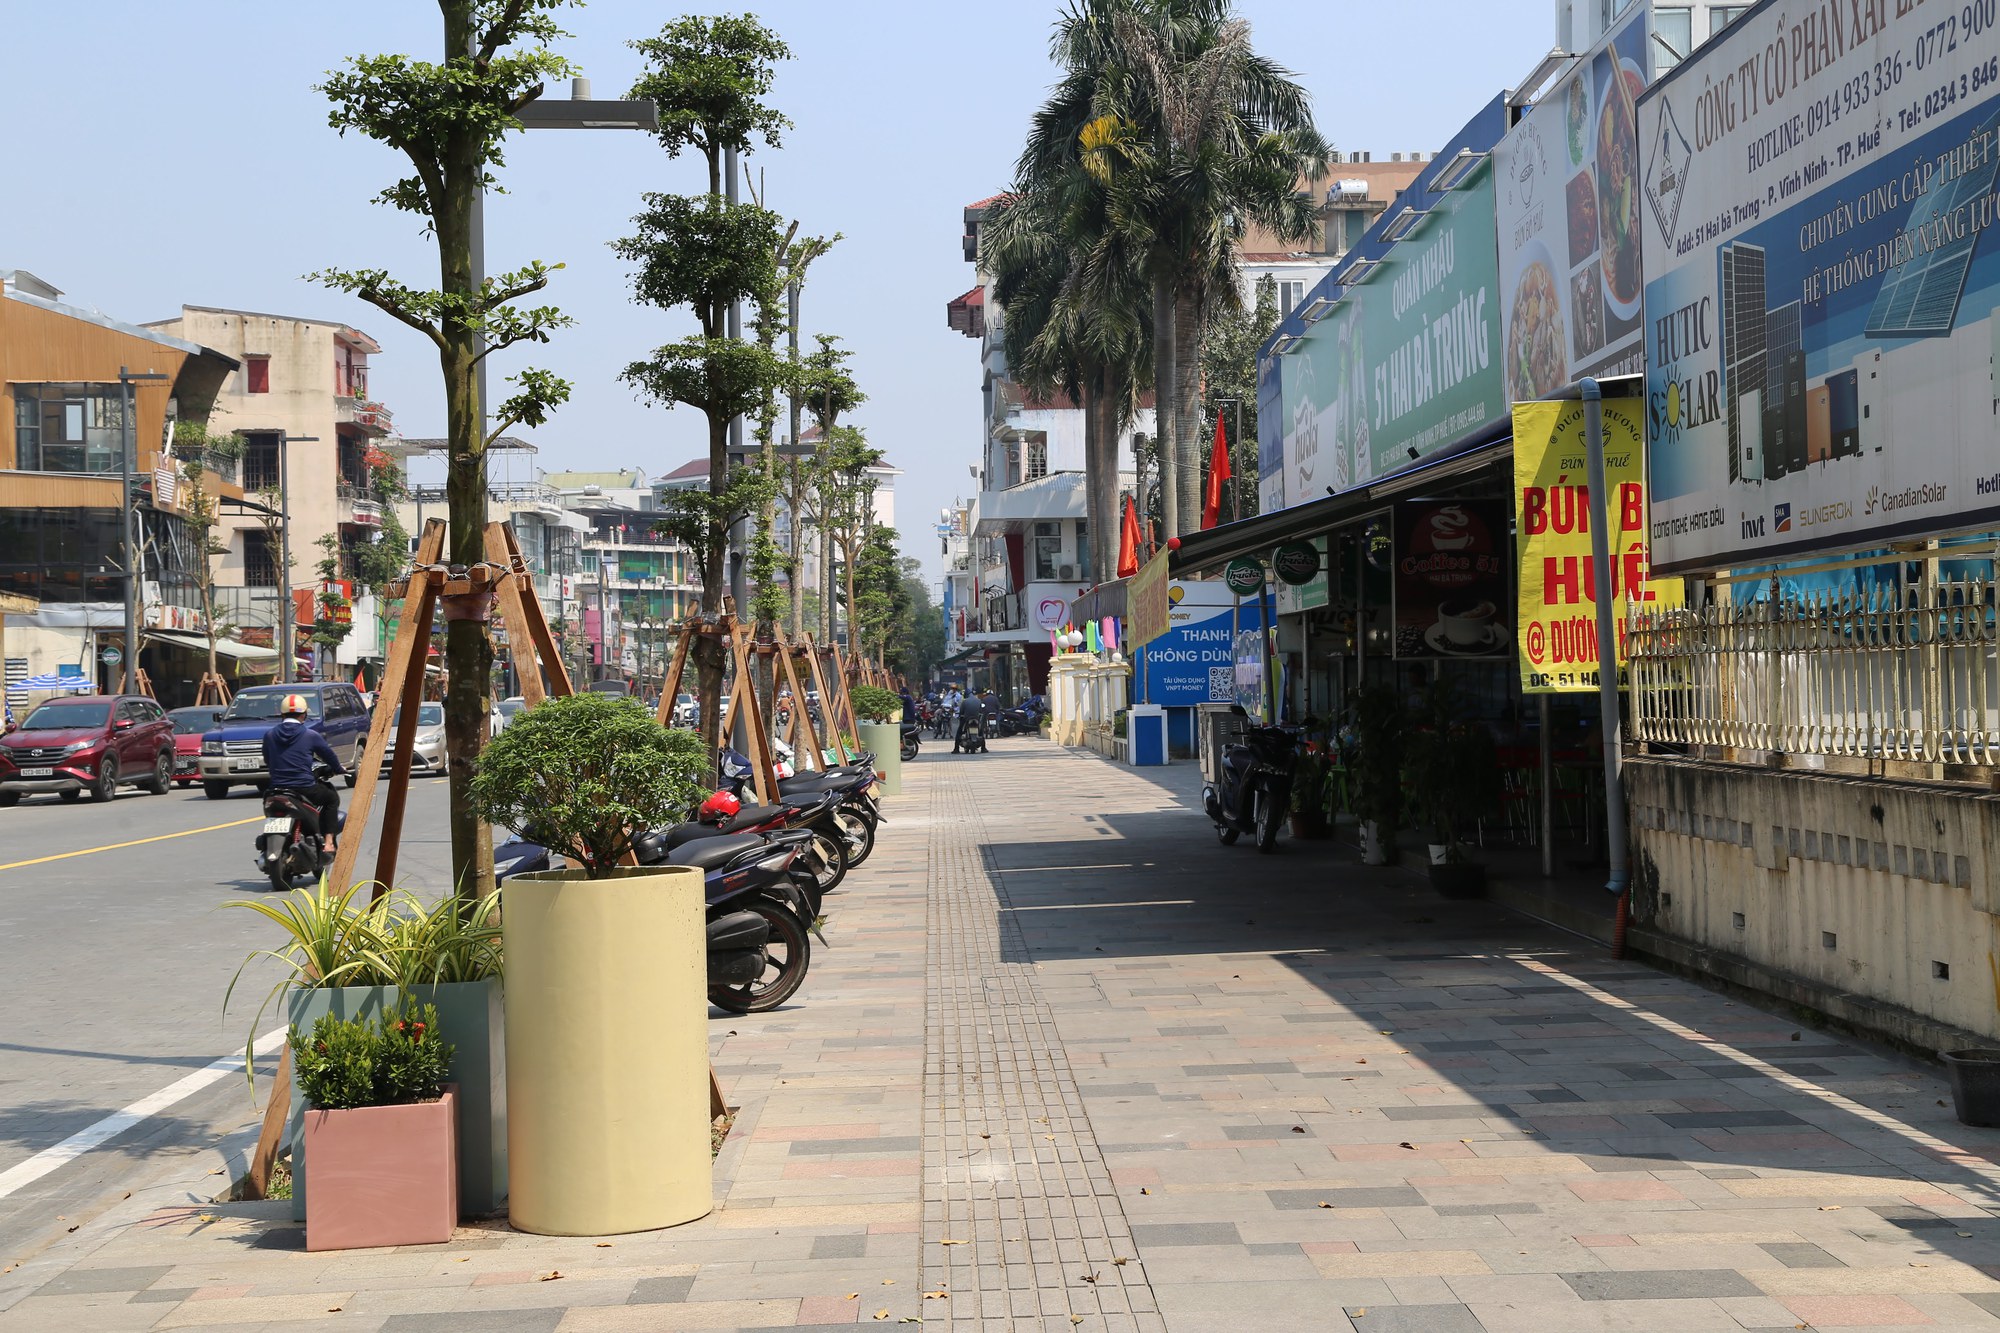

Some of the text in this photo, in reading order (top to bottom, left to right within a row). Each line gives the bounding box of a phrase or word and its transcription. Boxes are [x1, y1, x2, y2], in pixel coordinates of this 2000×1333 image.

[1695, 74, 1735, 152] CÔNG
[1738, 53, 1760, 123] TY
[1764, 12, 1787, 106] CỔ
[1748, 114, 1804, 174] HOTLINE:
[1807, 90, 1841, 137] 0914
[1844, 71, 1870, 115] 933
[1874, 50, 1902, 97] 336
[1916, 15, 1957, 71] 0772
[1962, 0, 1996, 43] 900
[1676, 231, 1694, 258] Add:
[1695, 225, 1704, 247] 51
[1706, 216, 1719, 241] Hai
[1721, 210, 1732, 233] bà
[1733, 198, 1760, 225] Trưng
[1768, 186, 1777, 207] P.
[1779, 170, 1801, 199] Vĩnh
[1803, 155, 1828, 187] Ninh
[1837, 141, 1854, 167] TP.
[1857, 119, 1881, 157] Huế
[1898, 101, 1921, 132] Tel:
[1924, 80, 1957, 118] 0234
[1960, 74, 1967, 99] 3
[1972, 56, 1998, 92] 846
[1800, 200, 1853, 253] CHUYÊN
[1857, 179, 1898, 224] CUNG
[1901, 155, 1933, 203] CẤP
[1937, 125, 1991, 186] THIẾT
[1392, 228, 1454, 321] QUÁN NHẬU
[1803, 266, 1821, 307] HỆ
[1823, 248, 1873, 295] THỐNG
[1877, 228, 1914, 273] ĐIỆN
[1918, 208, 1965, 256] NĂNG
[1375, 286, 1489, 431] 51 HAI BÀ TRƯNG
[1655, 294, 1711, 369] HUTIC
[1603, 408, 1641, 442] HƯƠNG
[1560, 454, 1631, 470] BÚN HUẾ
[1653, 504, 1725, 540] CÔNG NGHỆ HÀNG ĐẦU
[1741, 511, 1765, 540] invt
[1775, 508, 1785, 518] SMA
[1800, 501, 1853, 527] SUNGROW
[1881, 482, 1947, 512] CanadianSolar
[1401, 552, 1501, 575] Coffee 51
[1181, 629, 1230, 641] THANH
[1527, 620, 1545, 665] @
[1550, 615, 1600, 664] DƯƠN
[1188, 677, 1206, 686] DỤNG
[1530, 672, 1554, 687] ĐC:
[1559, 672, 1575, 687] 51
[1580, 671, 1600, 687] HA
